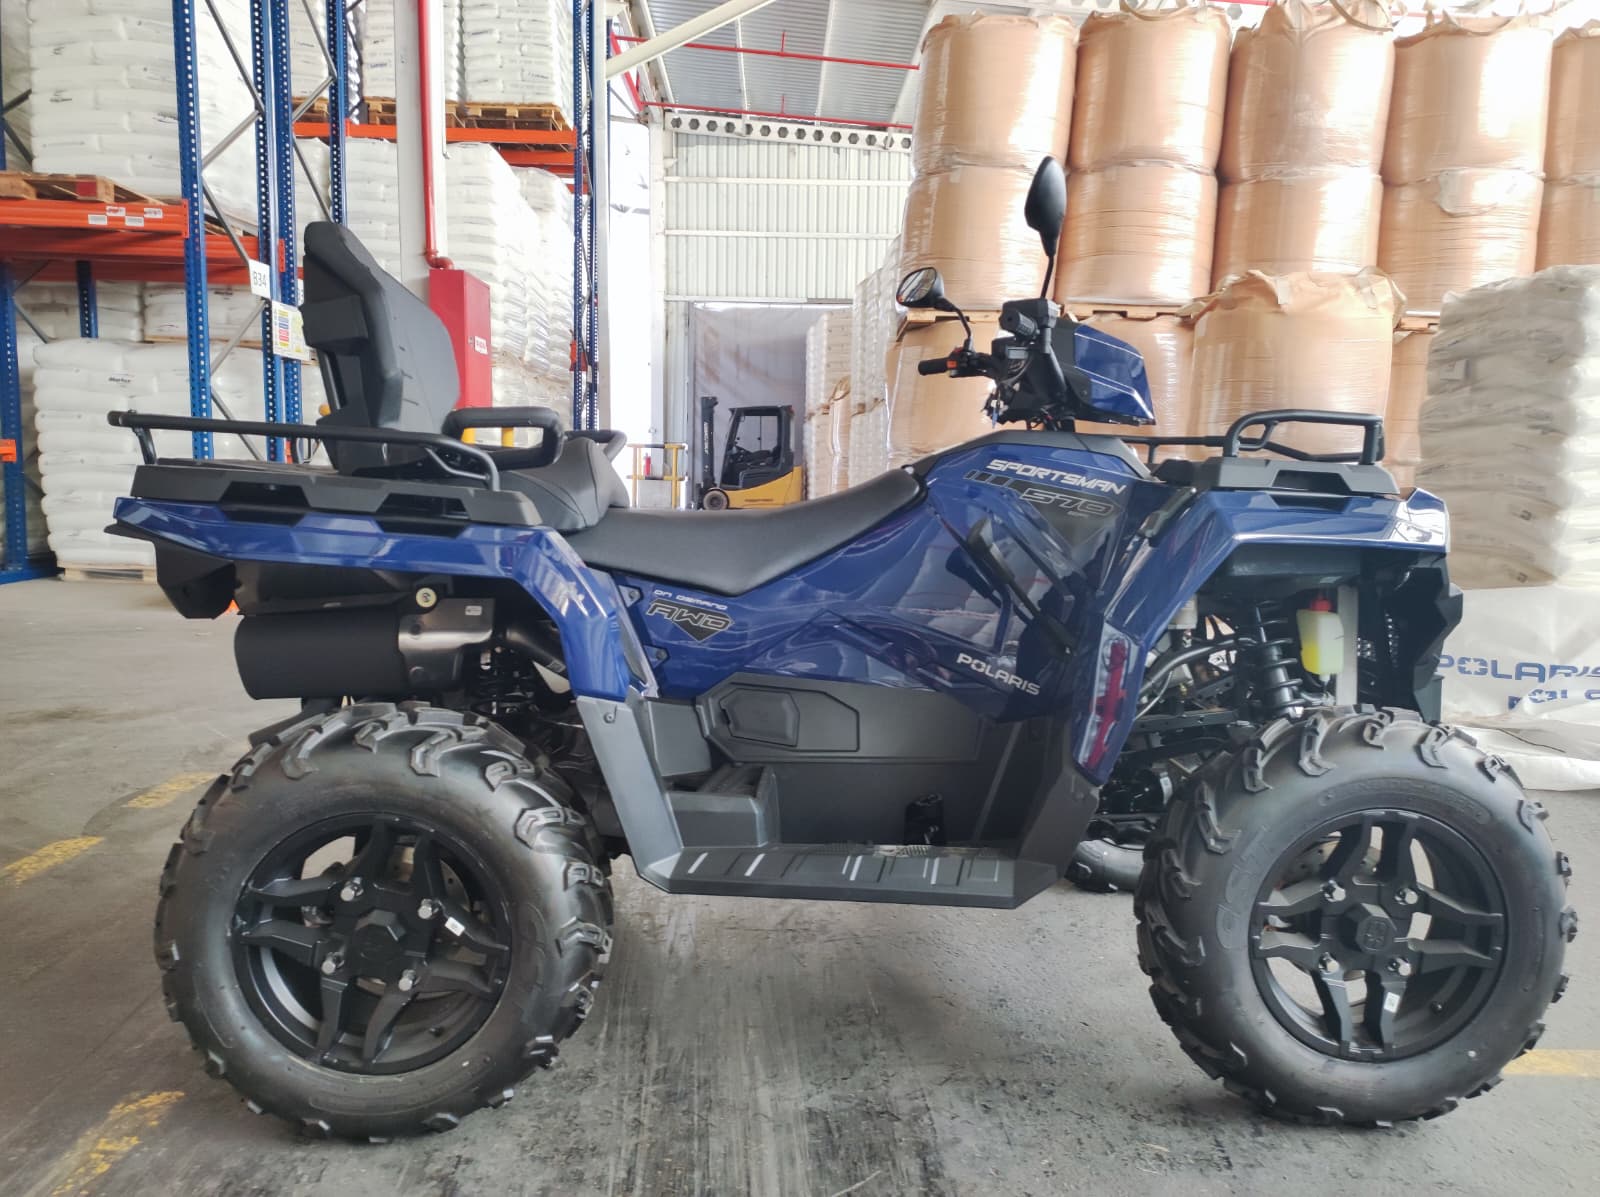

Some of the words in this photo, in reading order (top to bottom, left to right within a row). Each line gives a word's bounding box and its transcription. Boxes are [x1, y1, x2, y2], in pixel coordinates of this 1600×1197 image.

[986, 459, 1127, 495] SPORTSMAN
[645, 602, 732, 631] AWD
[956, 652, 1041, 695] POLARIS
